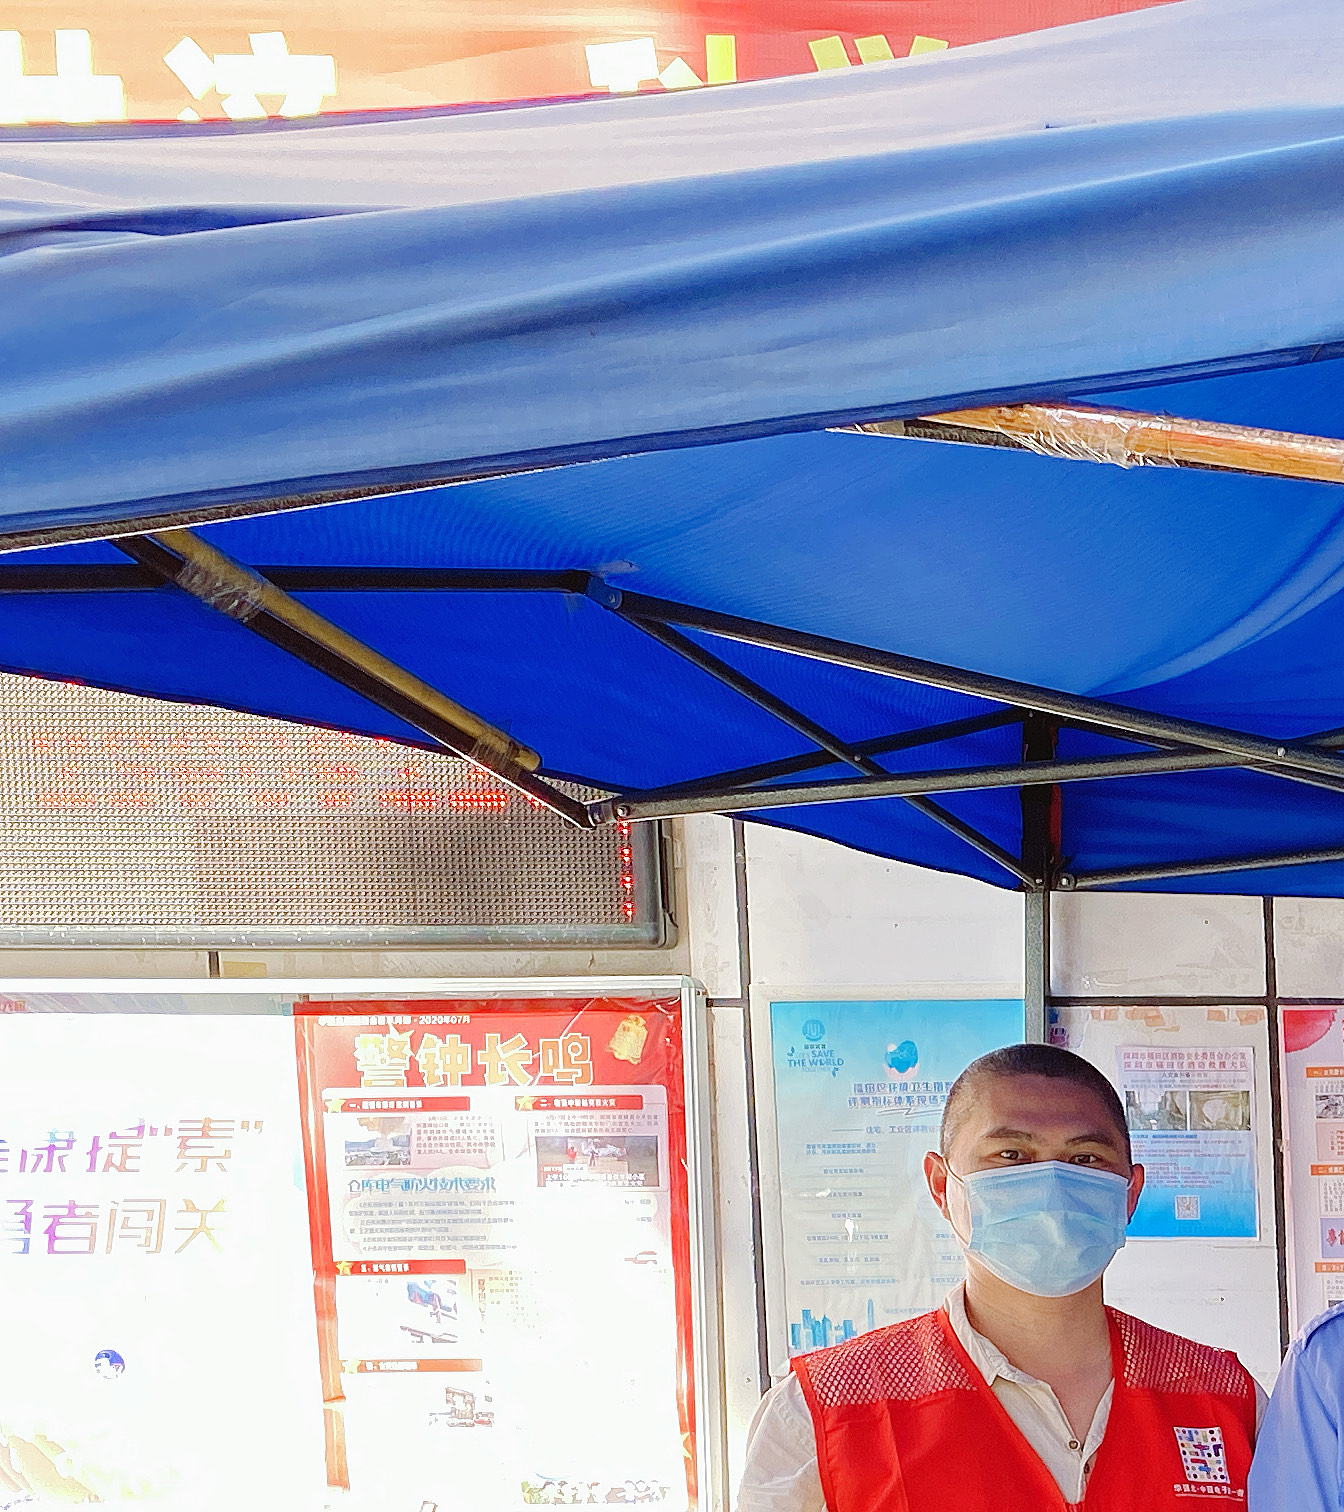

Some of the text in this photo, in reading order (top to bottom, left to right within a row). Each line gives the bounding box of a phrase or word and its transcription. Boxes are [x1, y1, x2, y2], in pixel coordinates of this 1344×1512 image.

[811, 1050, 834, 1058] SAVE
[353, 1031, 594, 1087] 警钟长鸣
[787, 1059, 806, 1067] THE
